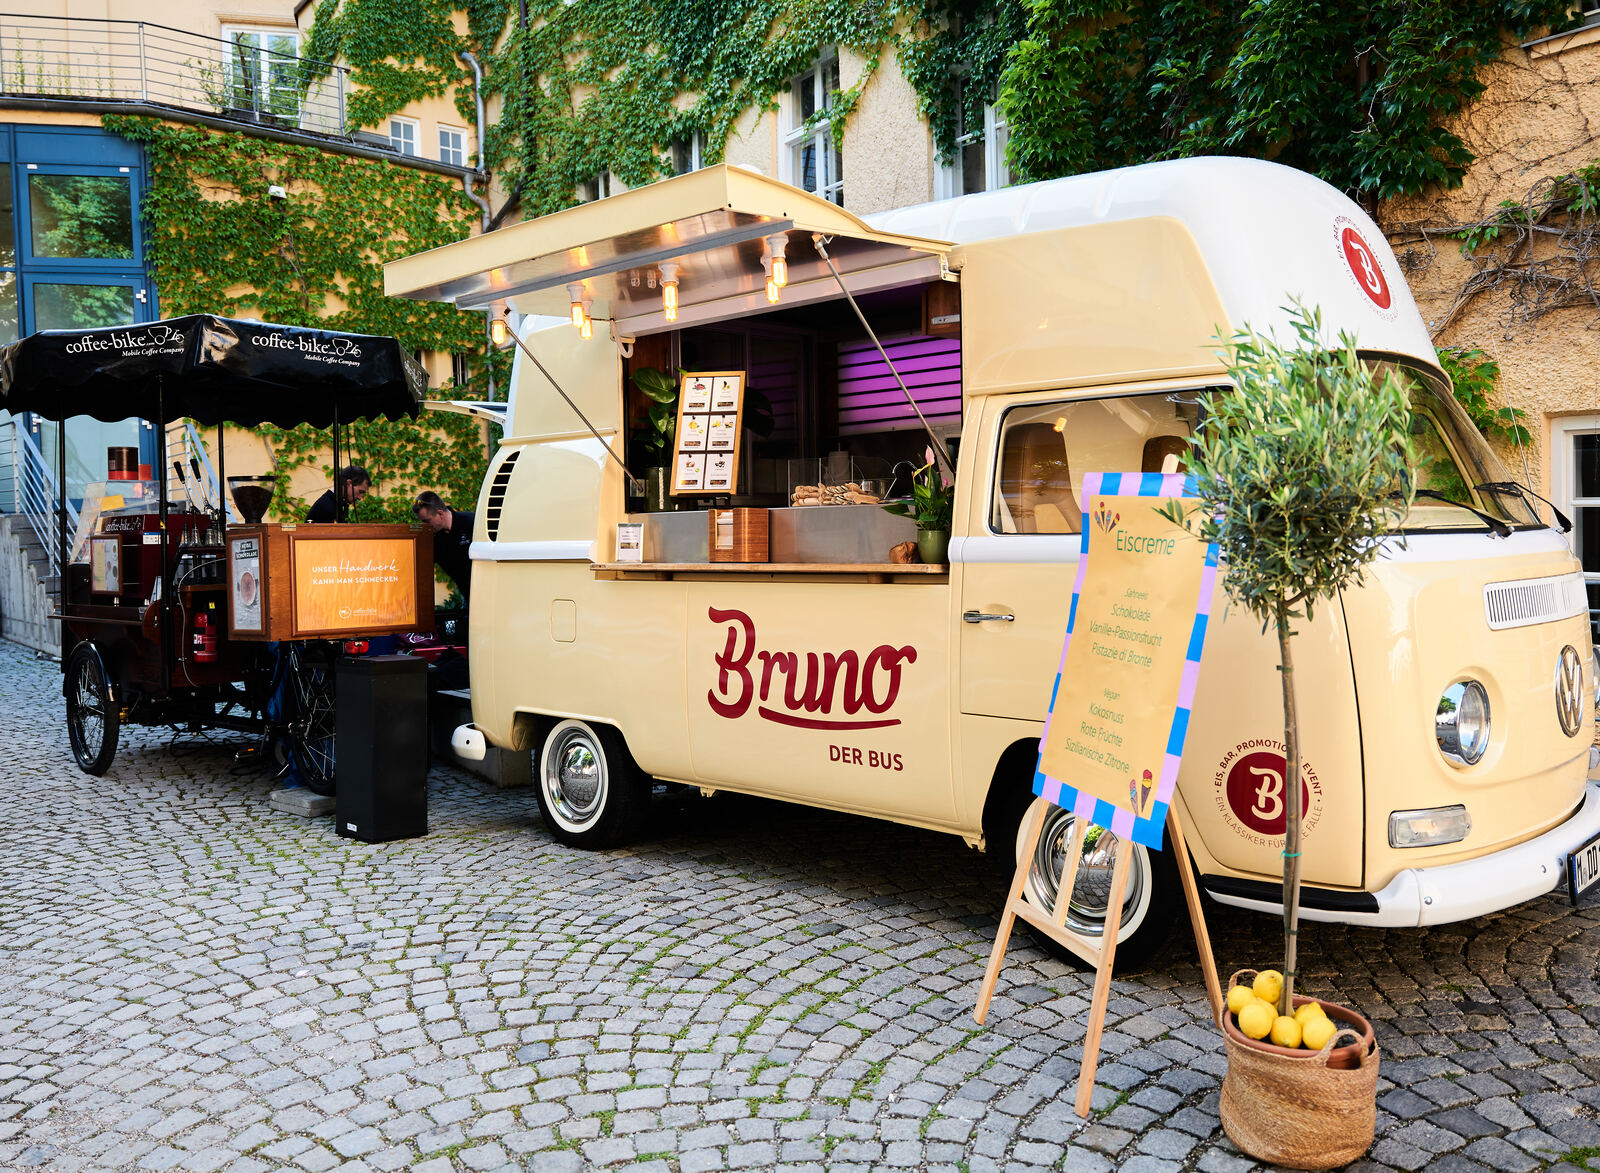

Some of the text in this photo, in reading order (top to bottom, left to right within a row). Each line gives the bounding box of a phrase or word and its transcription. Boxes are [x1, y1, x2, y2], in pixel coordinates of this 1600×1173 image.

[66, 331, 145, 354] coffee-bike
[122, 347, 185, 357] Mobile Coffee Company
[251, 332, 329, 354] coffee-bike
[304, 353, 322, 361] Mobile
[322, 355, 338, 364] Coffee
[338, 358, 361, 368] Company
[1116, 529, 1175, 555] Eiscreme
[312, 558, 400, 575] UNSER Handwerk
[312, 575, 399, 585] KANN MAN SCHMECKEN
[1111, 602, 1151, 622] Schokolade
[707, 606, 918, 720] Bruno
[1092, 641, 1153, 667] Pistazie di Bronte
[1089, 703, 1124, 724] Kokosnuss
[1080, 720, 1123, 747] Rote Früchte
[829, 744, 904, 771] DER BUS
[1065, 737, 1130, 773] Sizilianische Zitrone
[1236, 739, 1287, 753] PROMOTIO
[1302, 762, 1323, 796] EVENT
[1215, 796, 1323, 849] EIN KLASSIKER FÜR FÄLLE
